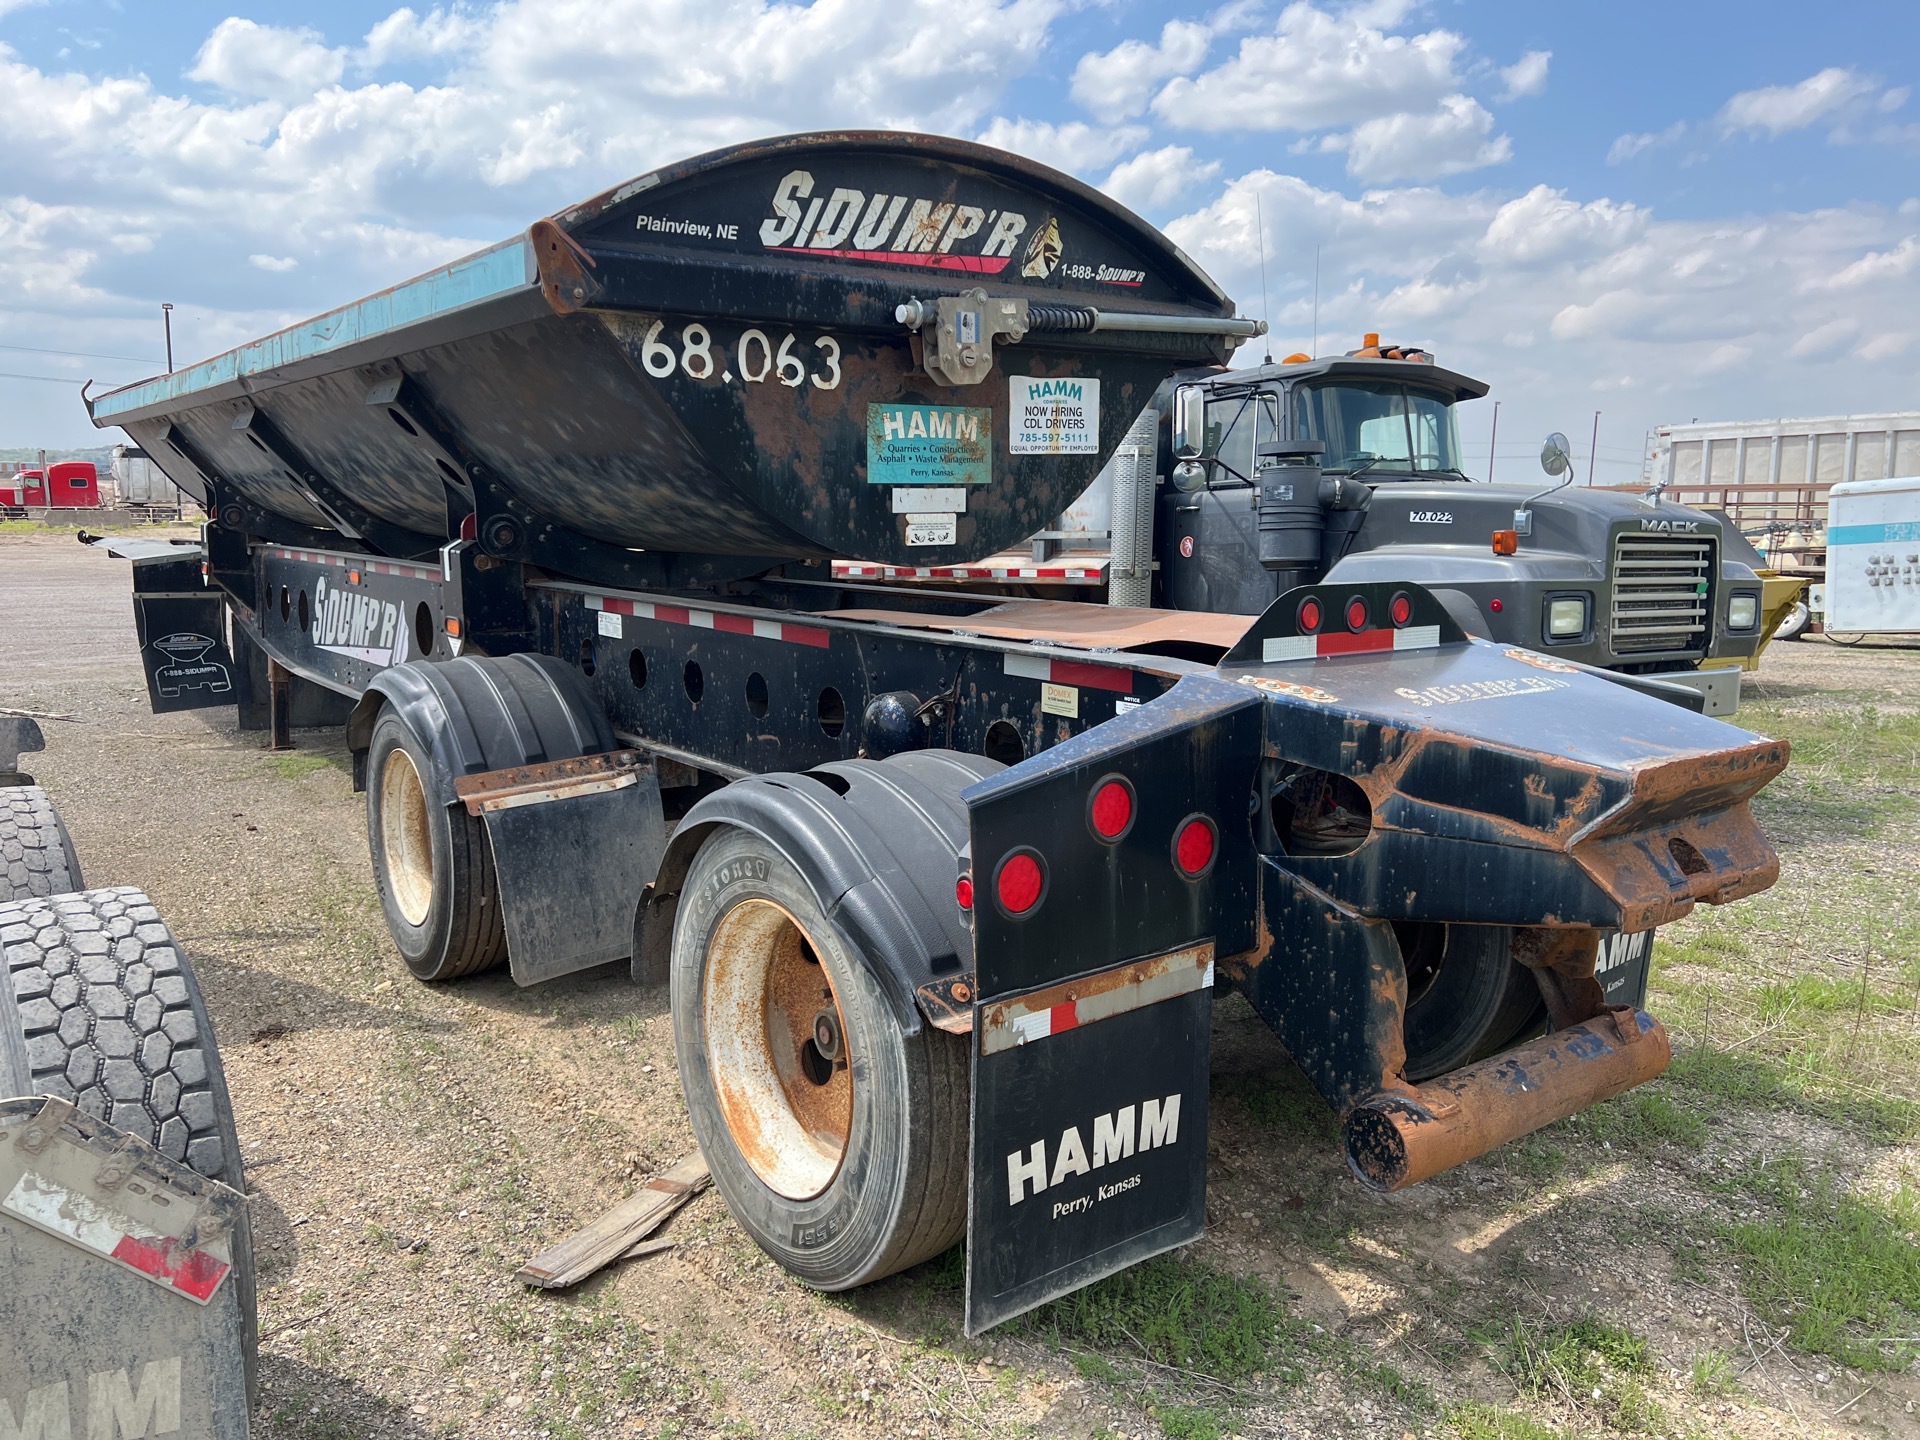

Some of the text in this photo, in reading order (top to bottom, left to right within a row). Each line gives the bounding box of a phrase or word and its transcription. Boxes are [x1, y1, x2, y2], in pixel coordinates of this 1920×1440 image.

[636, 214, 739, 241] Plainview, NE
[641, 319, 842, 391] 68.063
[1028, 380, 1083, 402] HAMM
[1025, 406, 1083, 417] NOW HIRING
[882, 410, 978, 442] HAMM
[1024, 418, 1085, 429] CDL DRIVERS
[1019, 433, 1089, 443] 785-597-5111
[887, 443, 977, 454] Quarries Construction
[1011, 445, 1029, 453] EQUAL
[877, 454, 984, 465] Asphalt Waste Management
[910, 468, 954, 477] Perry, Kansas
[1411, 511, 1452, 522] 70.022
[1640, 518, 1699, 534] MACK
[1007, 1093, 1182, 1207] HAMM
[1052, 1173, 1142, 1220] Perry, Kansas
